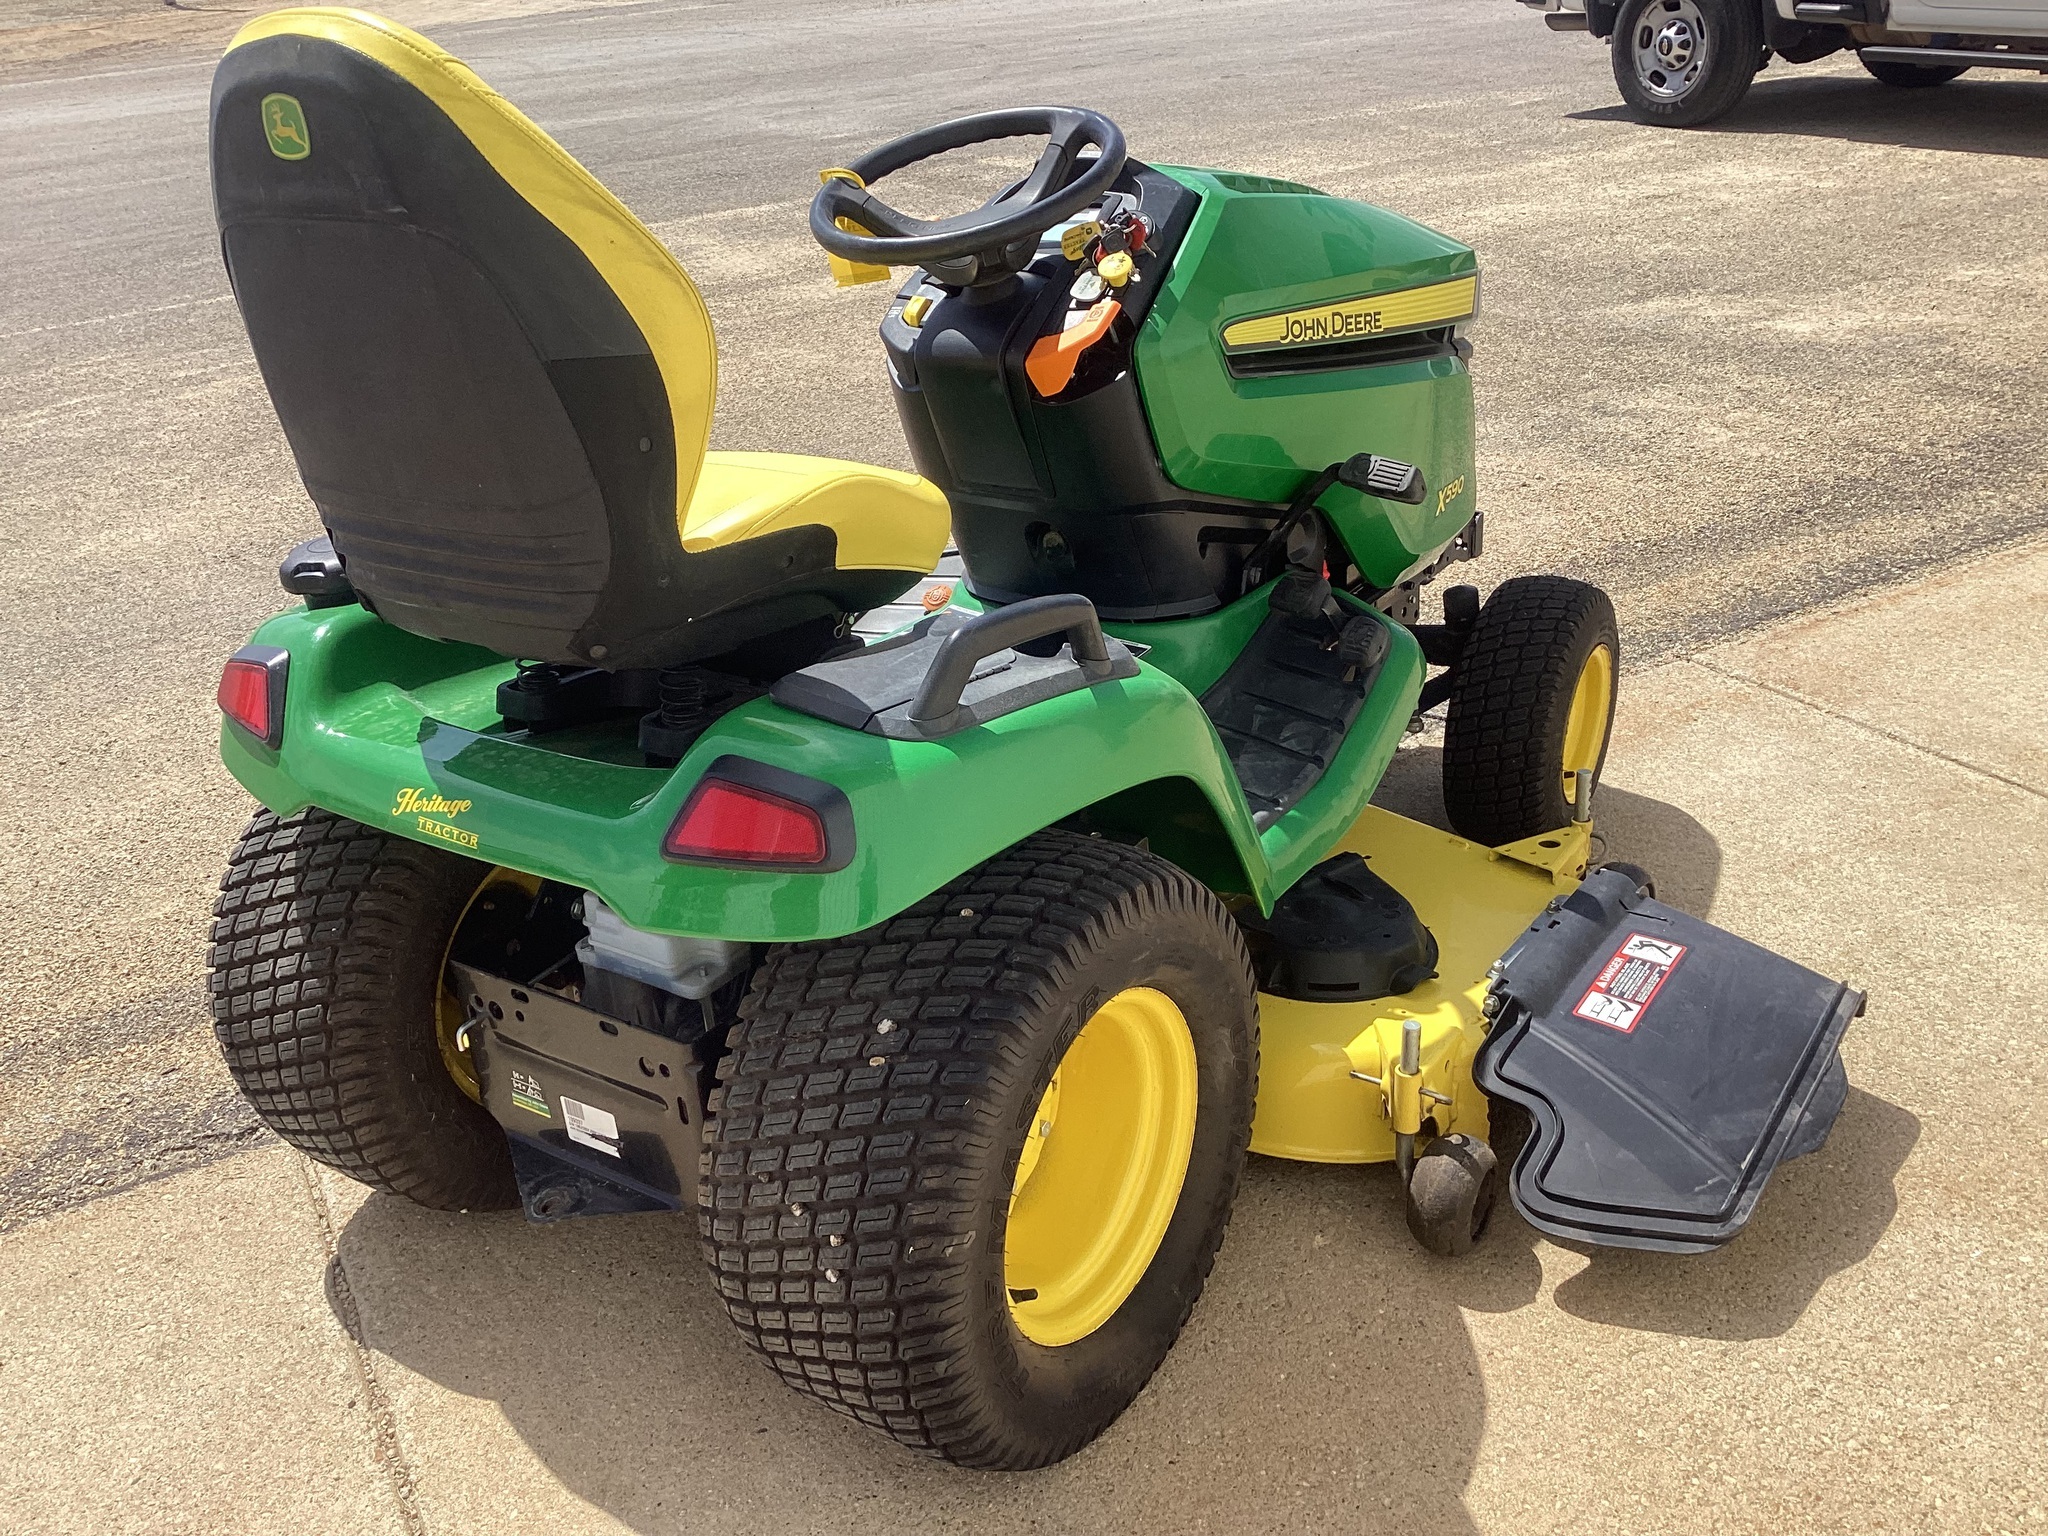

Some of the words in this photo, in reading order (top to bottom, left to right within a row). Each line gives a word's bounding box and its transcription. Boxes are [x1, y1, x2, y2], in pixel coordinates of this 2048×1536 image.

[1279, 316, 1329, 343] JOHN
[1331, 311, 1382, 336] DEERE
[1436, 475, 1465, 517] X590
[391, 787, 473, 819] Heritage
[418, 819, 479, 848] TRACTOR
[1601, 956, 1625, 982] DANGER
